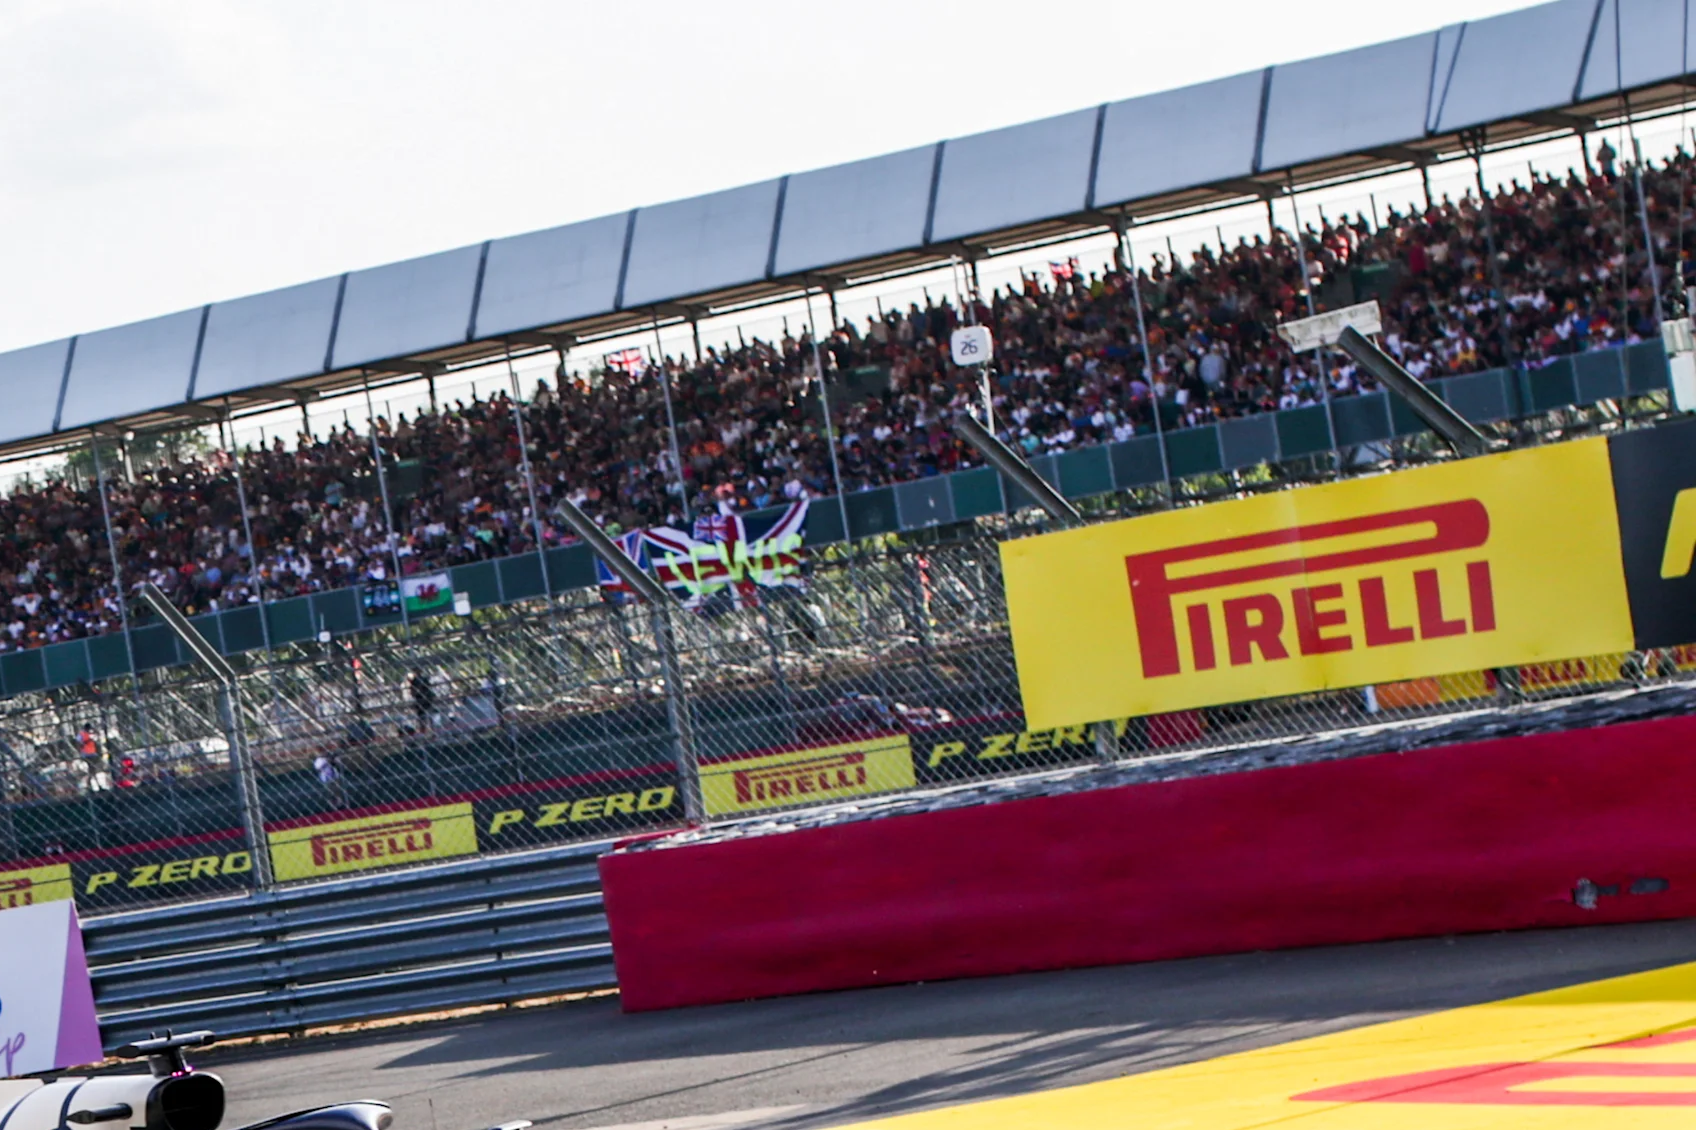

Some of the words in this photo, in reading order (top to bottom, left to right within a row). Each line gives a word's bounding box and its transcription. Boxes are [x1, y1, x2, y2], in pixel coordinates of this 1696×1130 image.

[960, 340, 979, 356] 26
[664, 533, 804, 595] LEWIS
[1125, 498, 1497, 679] PIRELLI
[733, 752, 867, 804] PIRELLI
[928, 741, 966, 768] P
[489, 809, 525, 835] P
[534, 786, 676, 828] ZERO
[311, 818, 433, 867] PIRELLI
[86, 871, 118, 895] P
[128, 851, 253, 888] ZERO
